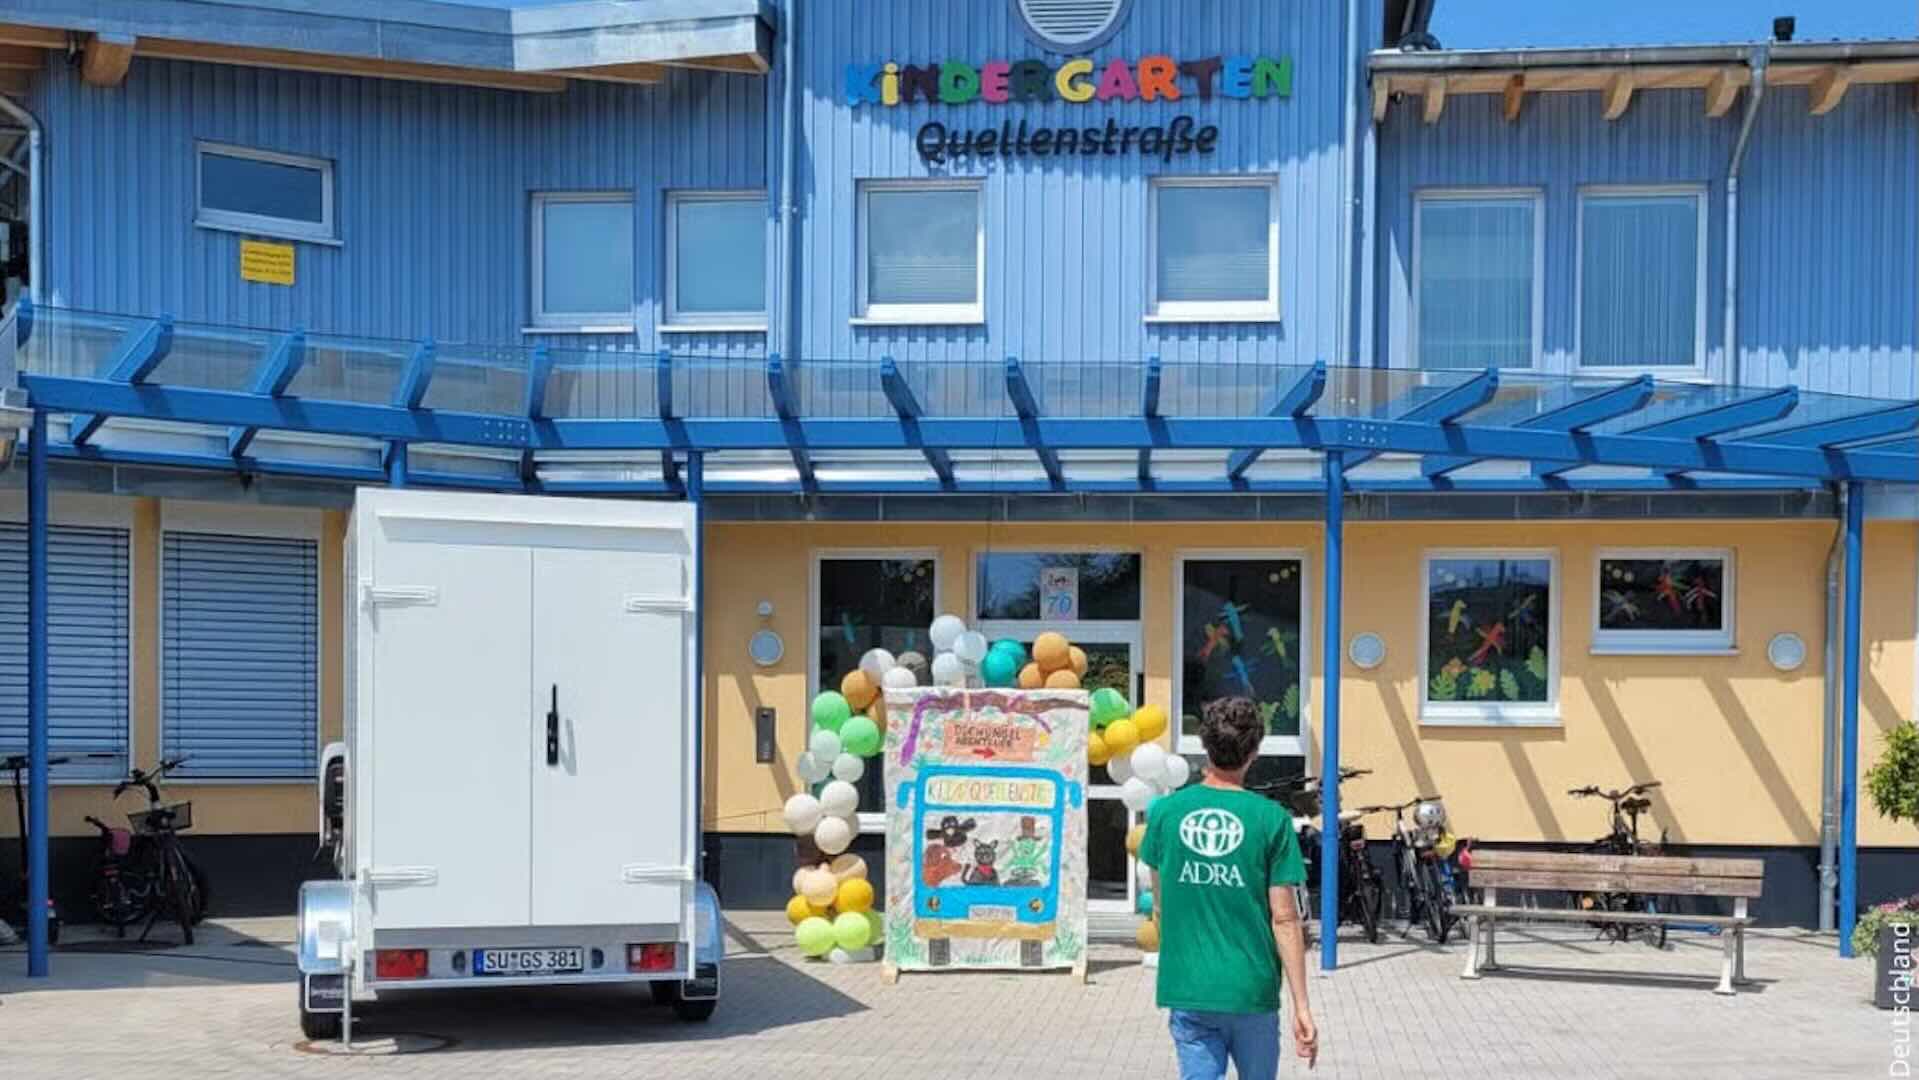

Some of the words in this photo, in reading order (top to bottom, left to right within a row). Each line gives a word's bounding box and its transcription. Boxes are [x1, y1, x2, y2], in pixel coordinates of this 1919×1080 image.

[845, 56, 1293, 106] KiNDERGARTEN
[916, 115, 1219, 164] Quellenstraße
[1178, 860, 1245, 888] ADRA
[486, 951, 509, 969] SU
[520, 951, 543, 968] GS
[547, 951, 578, 968] 381
